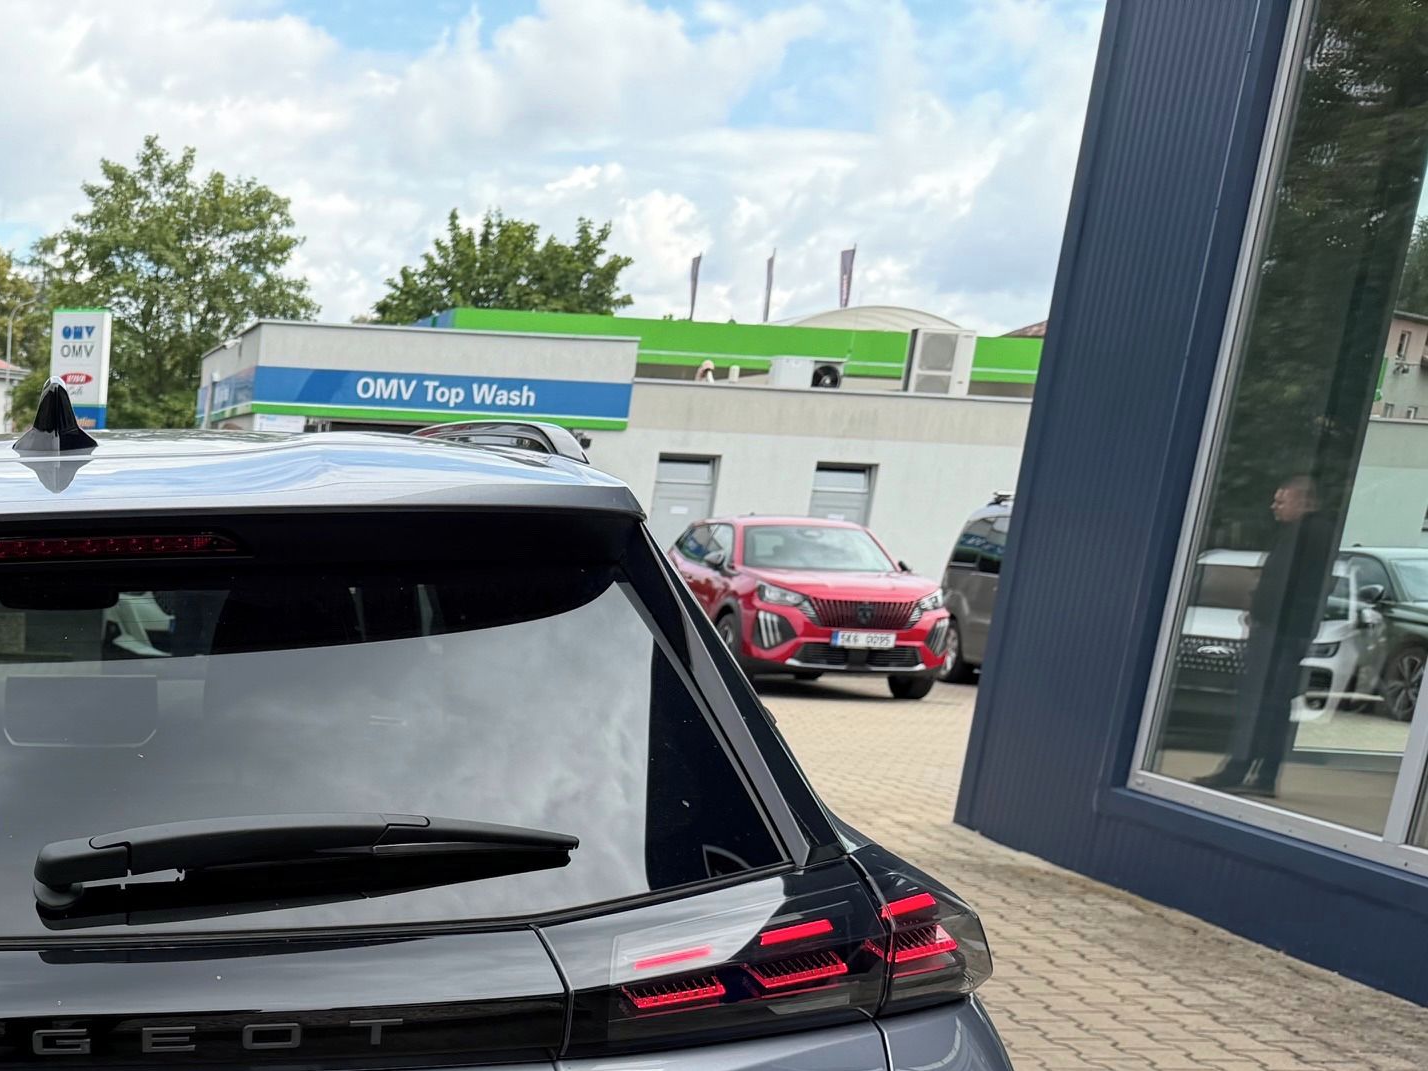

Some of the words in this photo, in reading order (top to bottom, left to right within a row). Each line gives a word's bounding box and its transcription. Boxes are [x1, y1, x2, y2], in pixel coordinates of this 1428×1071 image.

[62, 326, 95, 339] OMV
[60, 344, 94, 358] OMV
[356, 377, 417, 400] OMV
[423, 380, 465, 408] Top
[472, 383, 536, 407] Wash
